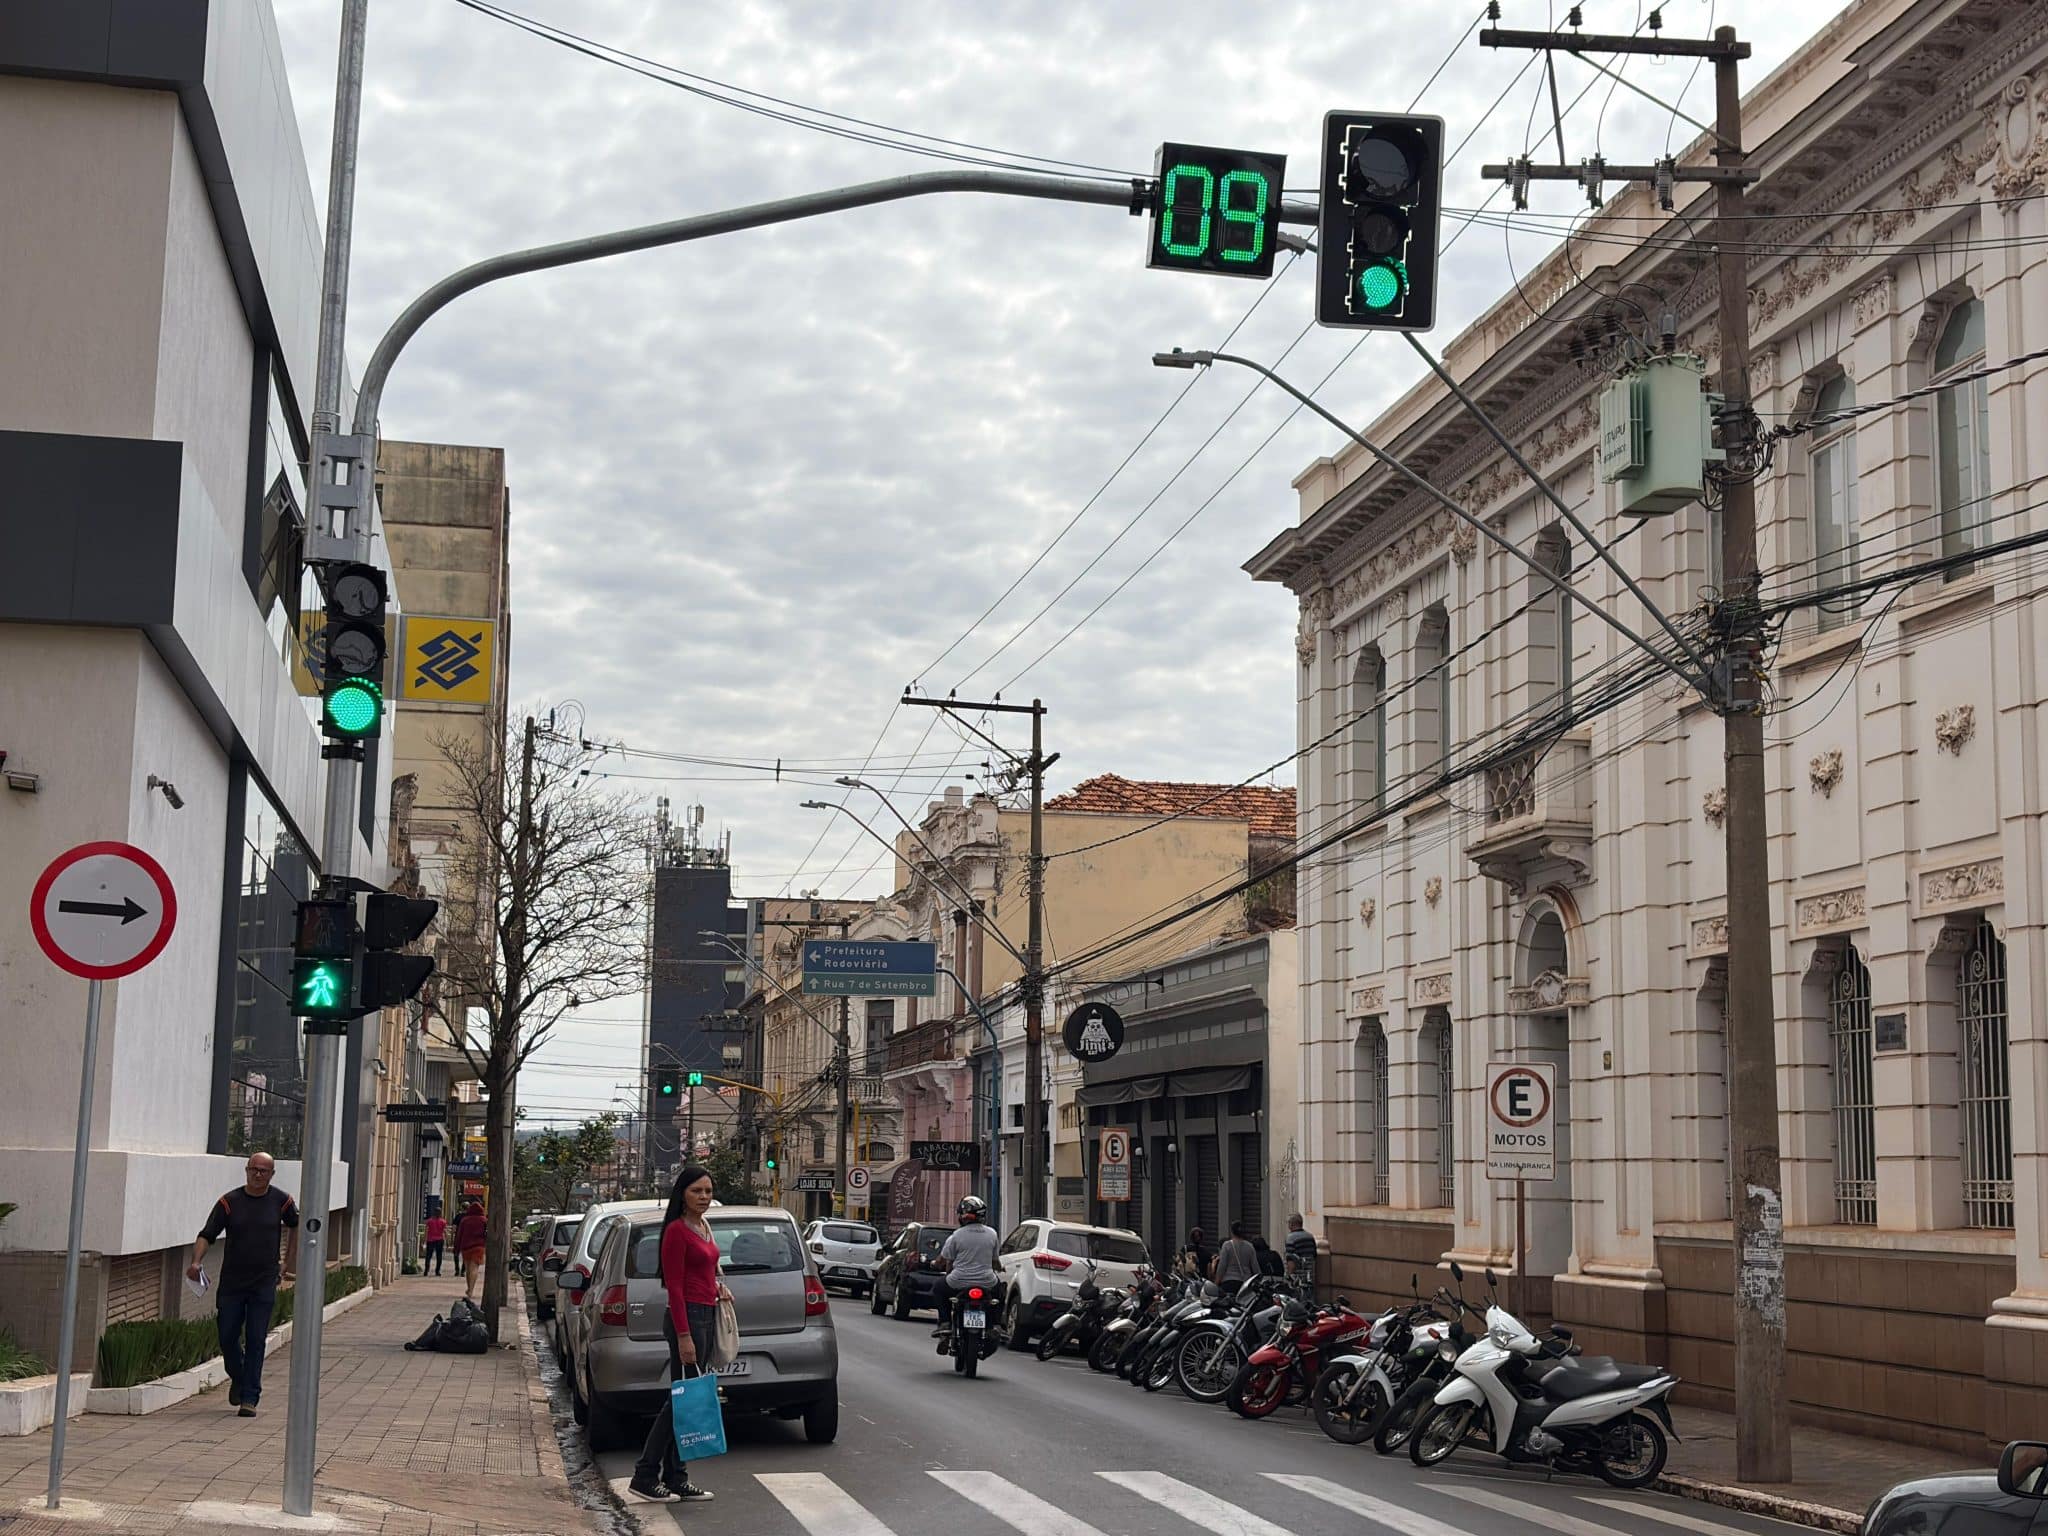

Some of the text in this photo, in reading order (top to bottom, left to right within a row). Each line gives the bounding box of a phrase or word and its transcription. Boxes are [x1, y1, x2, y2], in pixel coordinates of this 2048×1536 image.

[1162, 165, 1268, 262] 09
[824, 946, 885, 956] Prefeitura
[824, 959, 888, 969] Rodoviária
[824, 979, 928, 990] Rua 7 de Setembro
[1509, 1079, 1532, 1116] E
[1495, 1134, 1546, 1146] MOTOS
[1111, 1139, 1120, 1158] E
[800, 1179, 833, 1189] LOJAS SILVA
[854, 1172, 863, 1185] E
